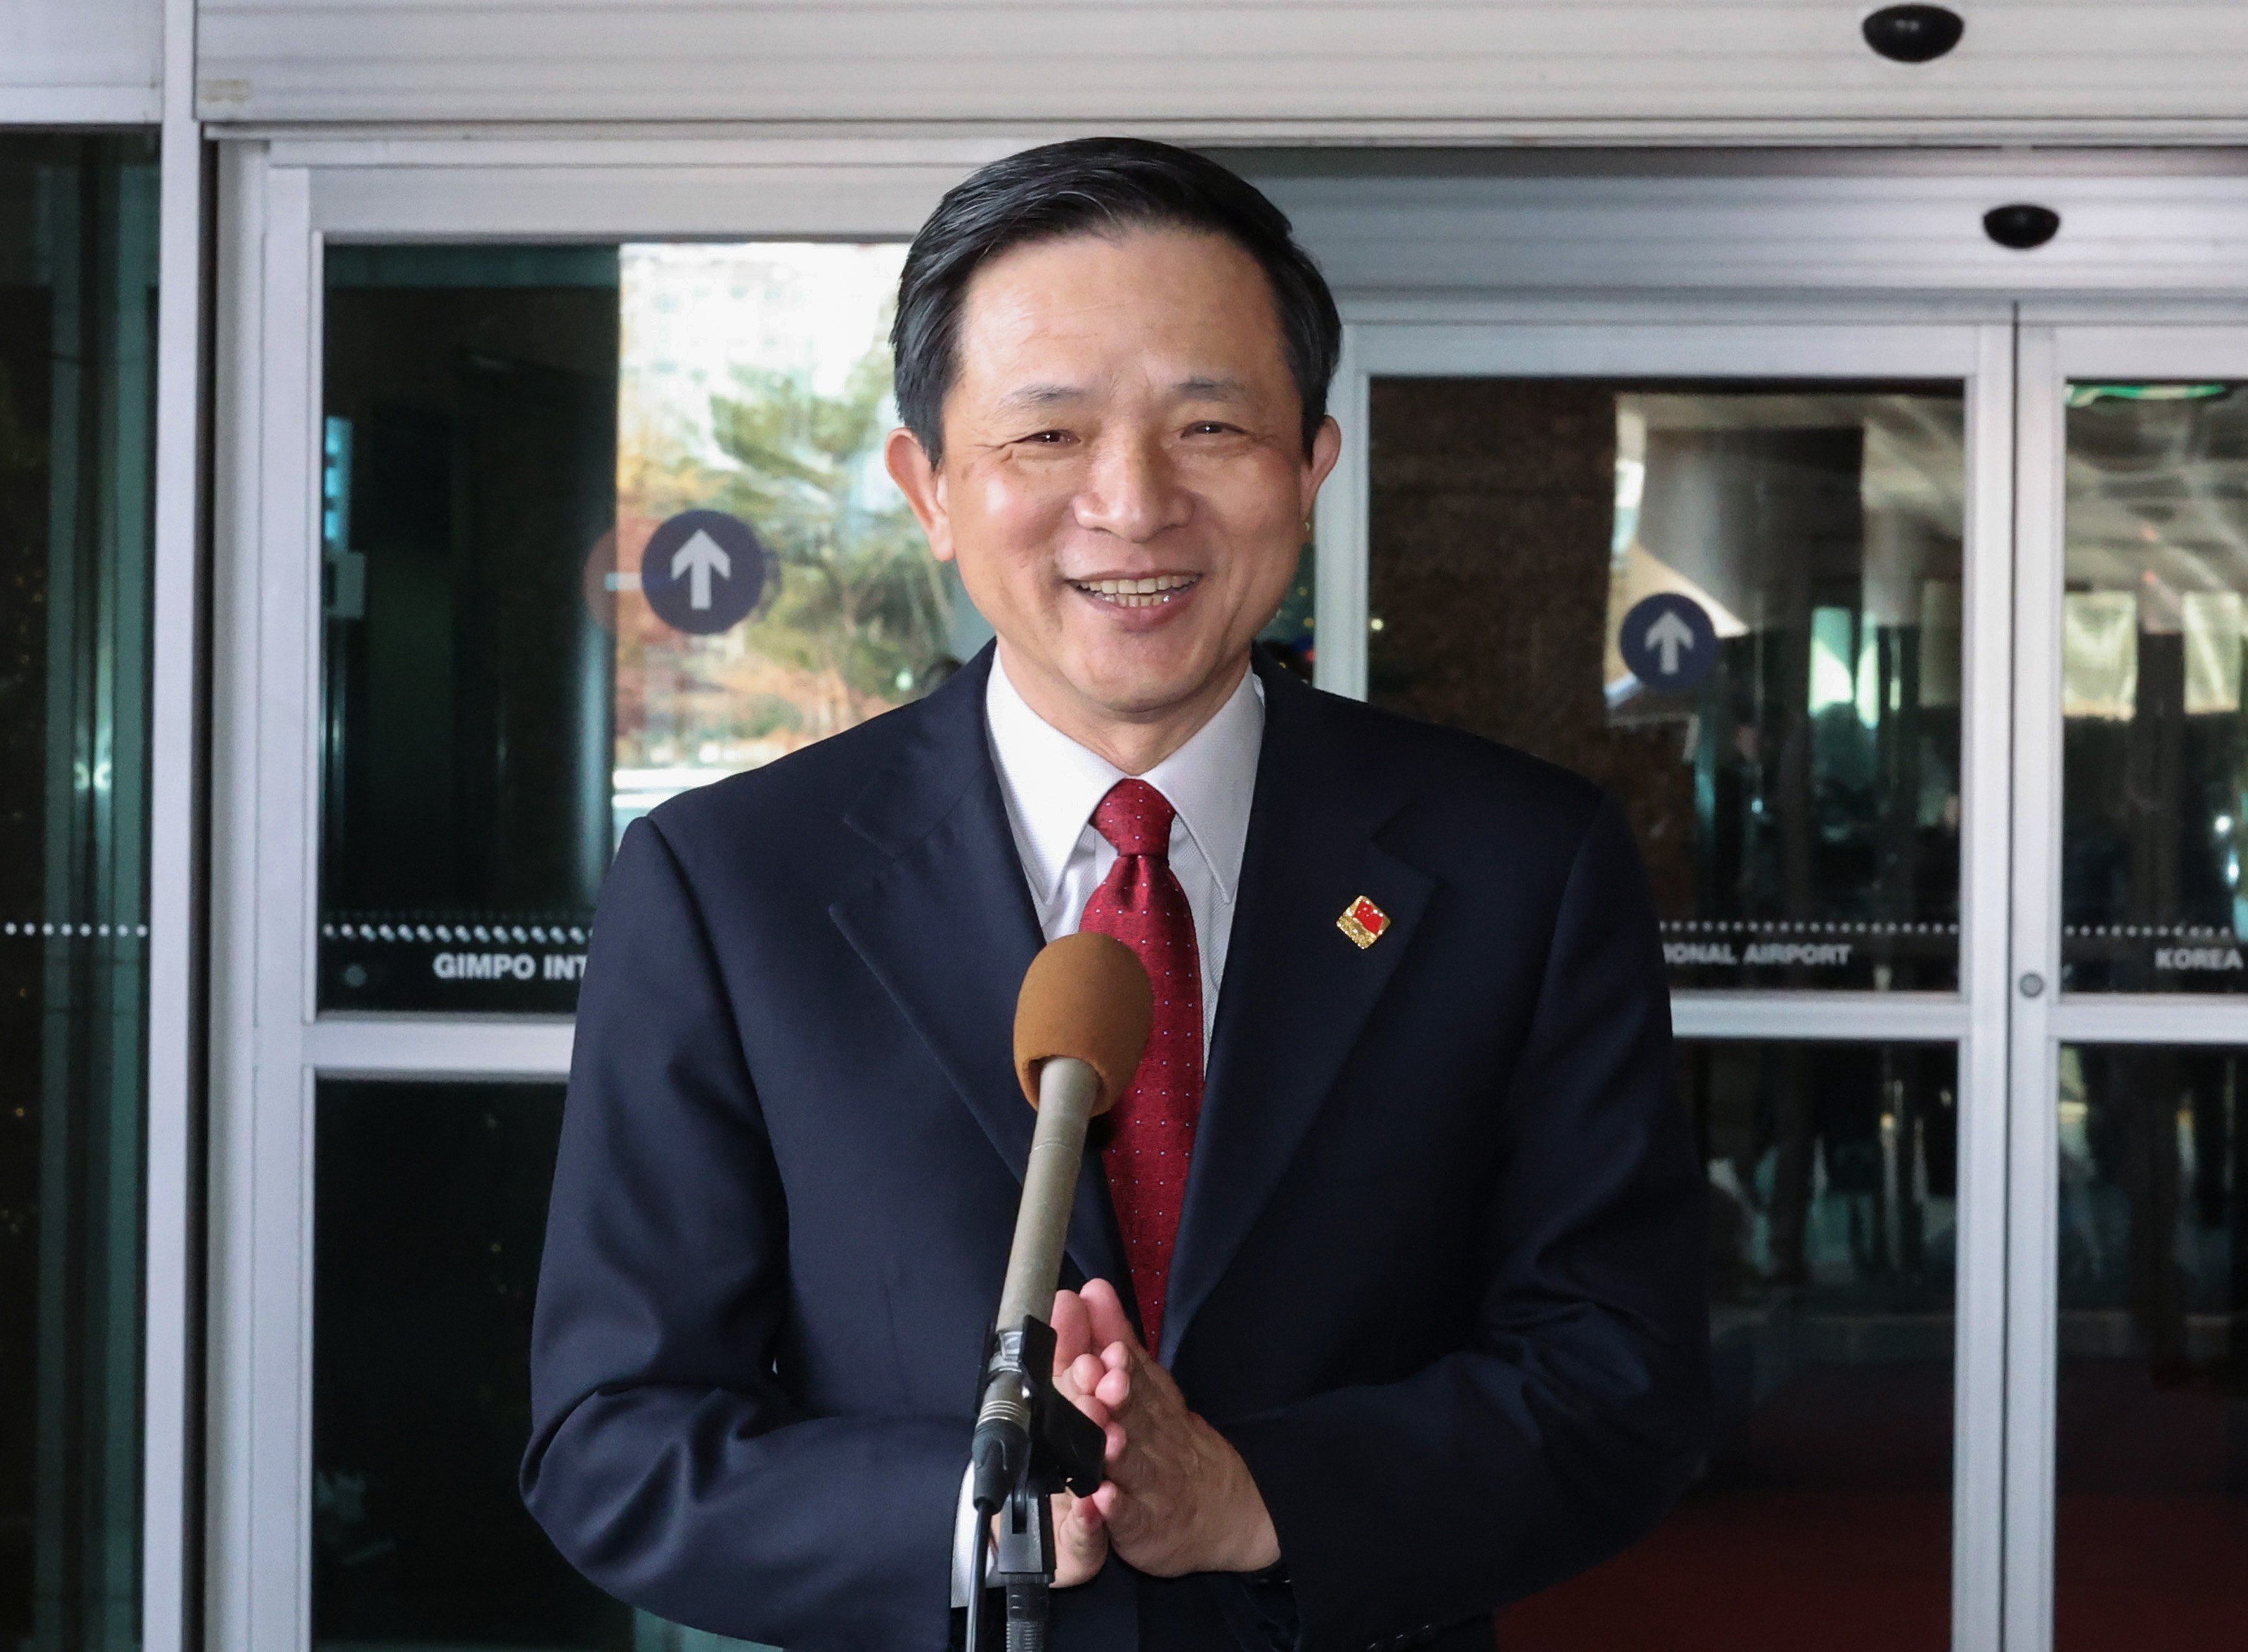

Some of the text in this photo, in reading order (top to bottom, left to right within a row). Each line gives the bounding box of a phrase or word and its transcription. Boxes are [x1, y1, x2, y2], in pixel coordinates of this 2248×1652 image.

[433, 953, 536, 979] GIMPO
[1743, 944, 1852, 966] AIRPORT
[2156, 947, 2244, 970] KOREA
